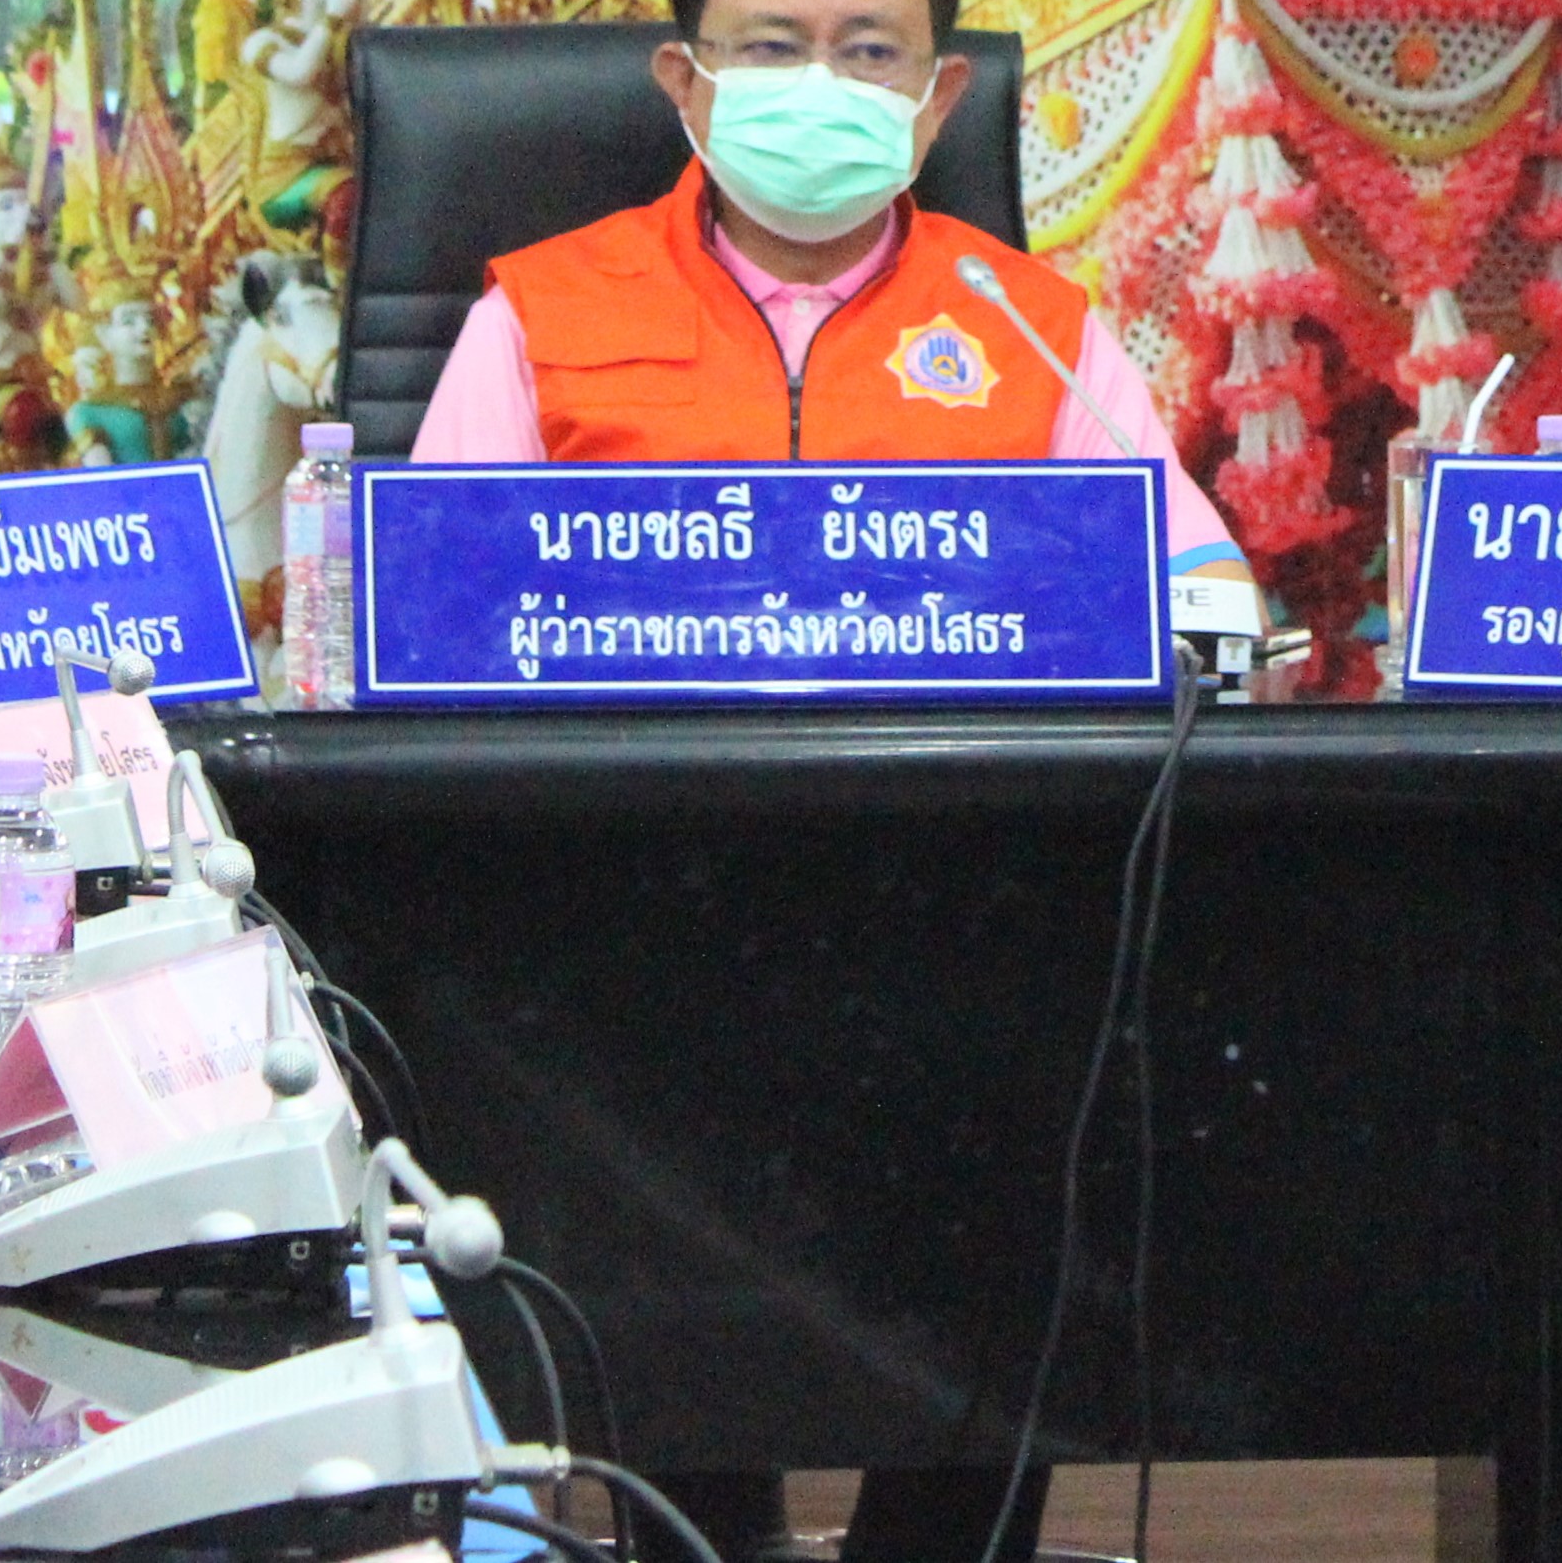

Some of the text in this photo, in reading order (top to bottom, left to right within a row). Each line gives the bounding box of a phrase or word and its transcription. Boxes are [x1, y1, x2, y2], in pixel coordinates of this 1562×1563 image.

[528, 480, 990, 563] นายชลธี ยังตรง
[509, 589, 1026, 681] ผู้ว่าราชการจังหวัดยโสธร
